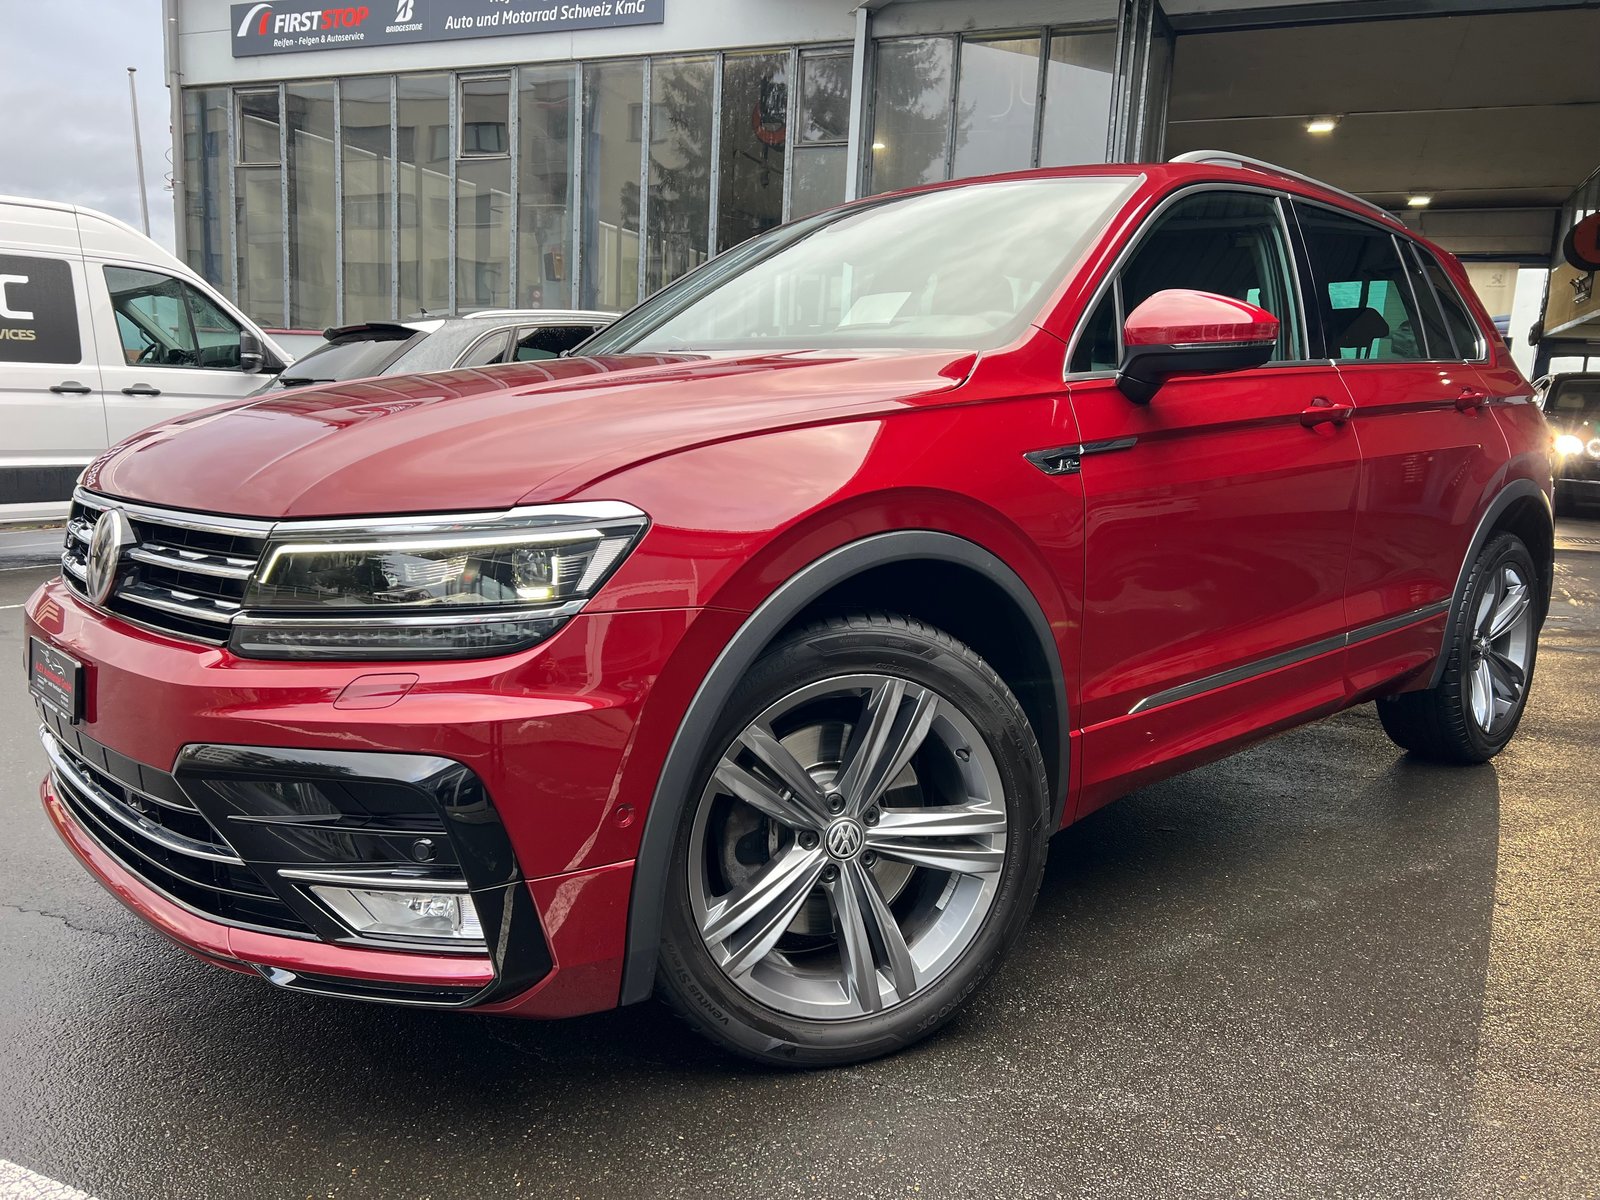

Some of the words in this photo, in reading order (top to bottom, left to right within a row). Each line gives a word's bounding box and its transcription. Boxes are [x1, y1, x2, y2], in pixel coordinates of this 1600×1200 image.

[445, 16, 473, 30] Auto
[476, 12, 499, 27] und
[502, 7, 558, 25] Motorrad
[560, 2, 612, 20] Schweiz
[615, 0, 646, 15] KmG
[385, 23, 423, 33] BRIDGESTONE
[273, 38, 294, 48] Reifen
[298, 36, 320, 46] Felgen
[320, 35, 326, 43] &
[326, 32, 365, 42] Autoservice
